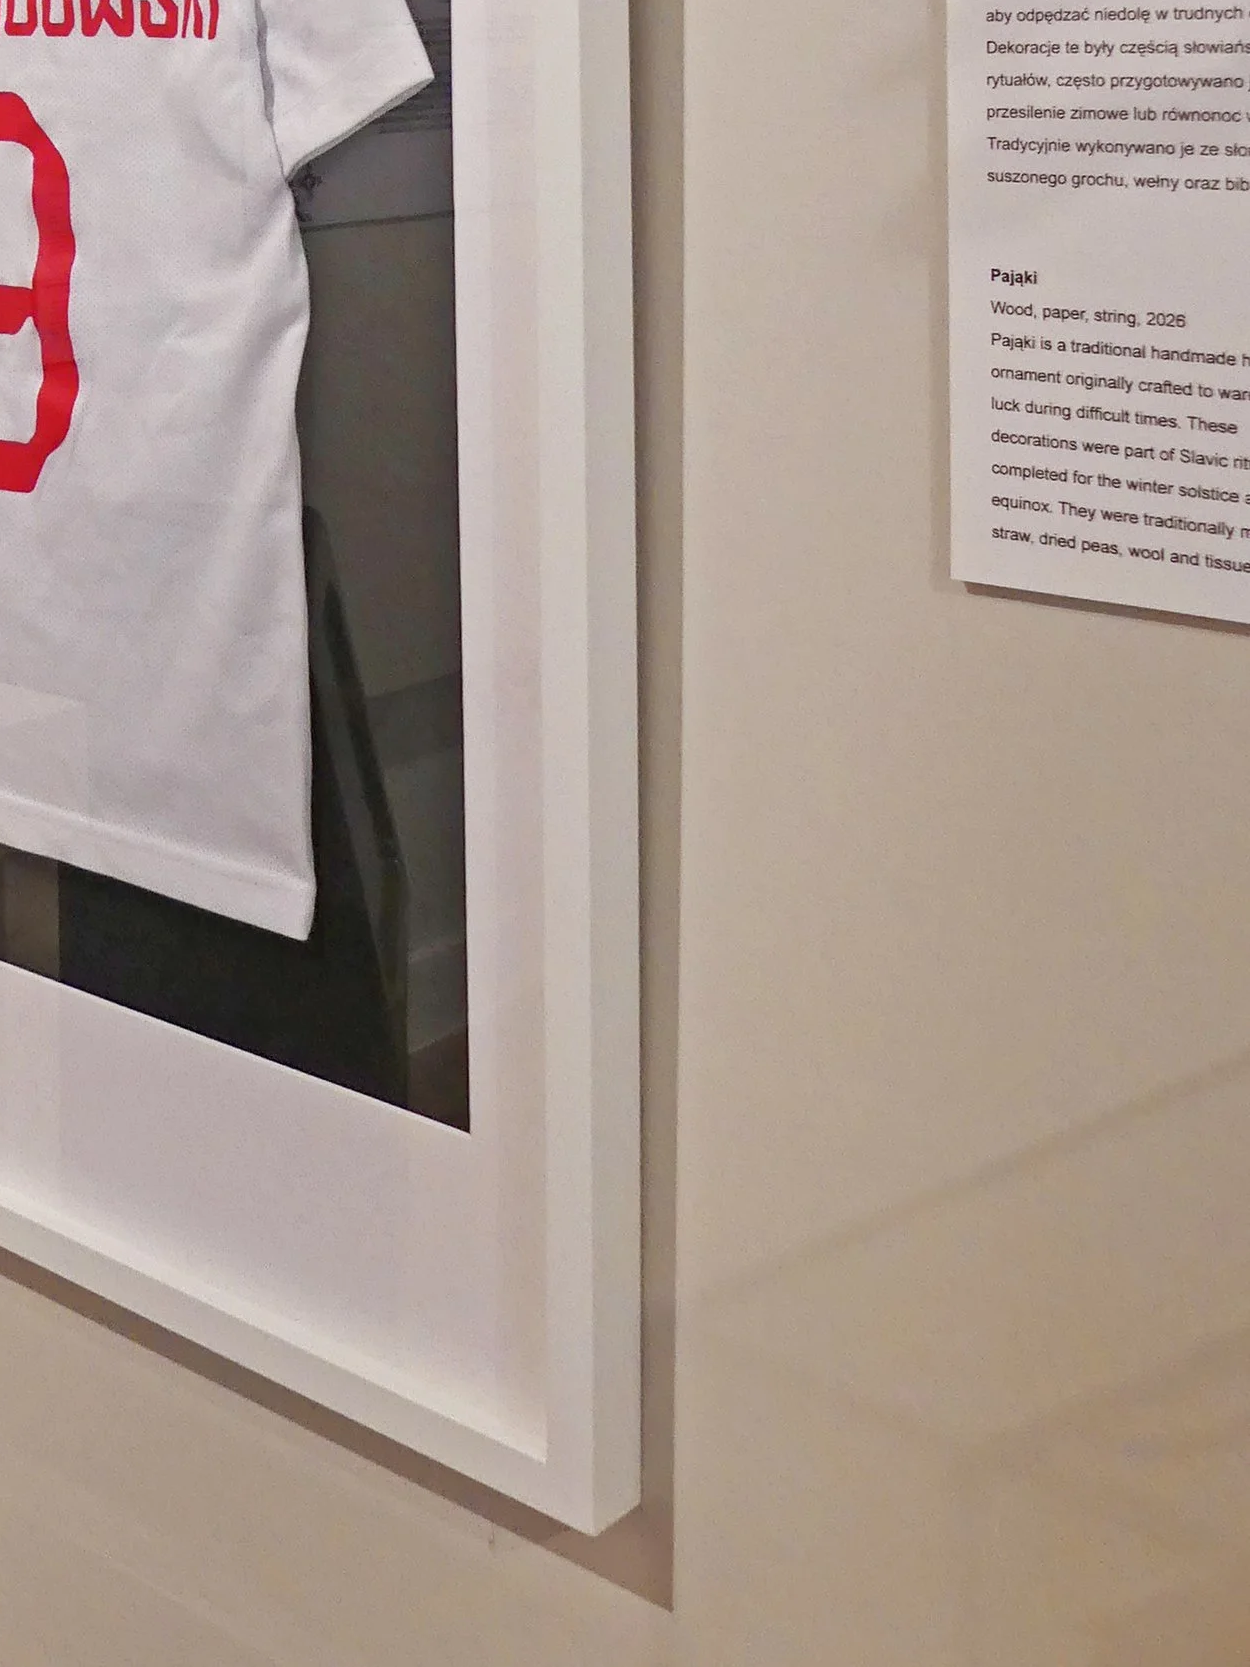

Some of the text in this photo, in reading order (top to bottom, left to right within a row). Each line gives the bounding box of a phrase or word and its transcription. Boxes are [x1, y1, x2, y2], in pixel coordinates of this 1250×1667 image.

[986, 6, 1243, 24] aby odpędzać niedolę w trudnych
[986, 41, 1060, 57] Dekoracje
[1066, 42, 1079, 54] te
[1085, 41, 1114, 57] były
[1120, 41, 1178, 57] częścią
[986, 73, 1244, 90] rytuałów, często przygotowywano
[986, 106, 1241, 122] przesilenie zimowe lub równonoc
[987, 136, 1250, 158] Tradycyjnie wykonywano je ze sło
[987, 170, 1066, 187] suszonego
[1072, 174, 1128, 188] grochu,
[1134, 176, 1178, 191] wełny
[1184, 179, 1220, 191] oraz
[991, 268, 1037, 287] Pająki
[991, 300, 1187, 328] Wood, paper, string, 2026
[991, 333, 1036, 351] Pająki
[1040, 335, 1052, 350] is
[1057, 340, 1066, 352] a
[1071, 340, 1146, 358] traditional
[1151, 346, 1236, 366] handmade
[991, 366, 1250, 401] ornament originally crafted to war
[991, 397, 1238, 434] luck during difficult times. These
[991, 429, 1077, 451] decorations
[1083, 441, 1120, 456] were
[1125, 446, 1154, 459] part
[1160, 448, 1175, 461] of
[1180, 448, 1228, 467] Slavic
[992, 463, 1067, 482] completed
[1073, 470, 1093, 484] for
[1098, 473, 1121, 488] the
[1126, 479, 1174, 495] winter
[1178, 484, 1239, 503] solstice
[991, 494, 1052, 513] equinox.
[1059, 501, 1095, 522] They
[1101, 510, 1138, 524] were
[1144, 514, 1234, 540] traditionally
[992, 526, 1033, 544] straw,
[1039, 533, 1076, 549] dried
[1082, 540, 1122, 557] peas,
[1129, 546, 1165, 561] wool
[1170, 552, 1199, 566] and
